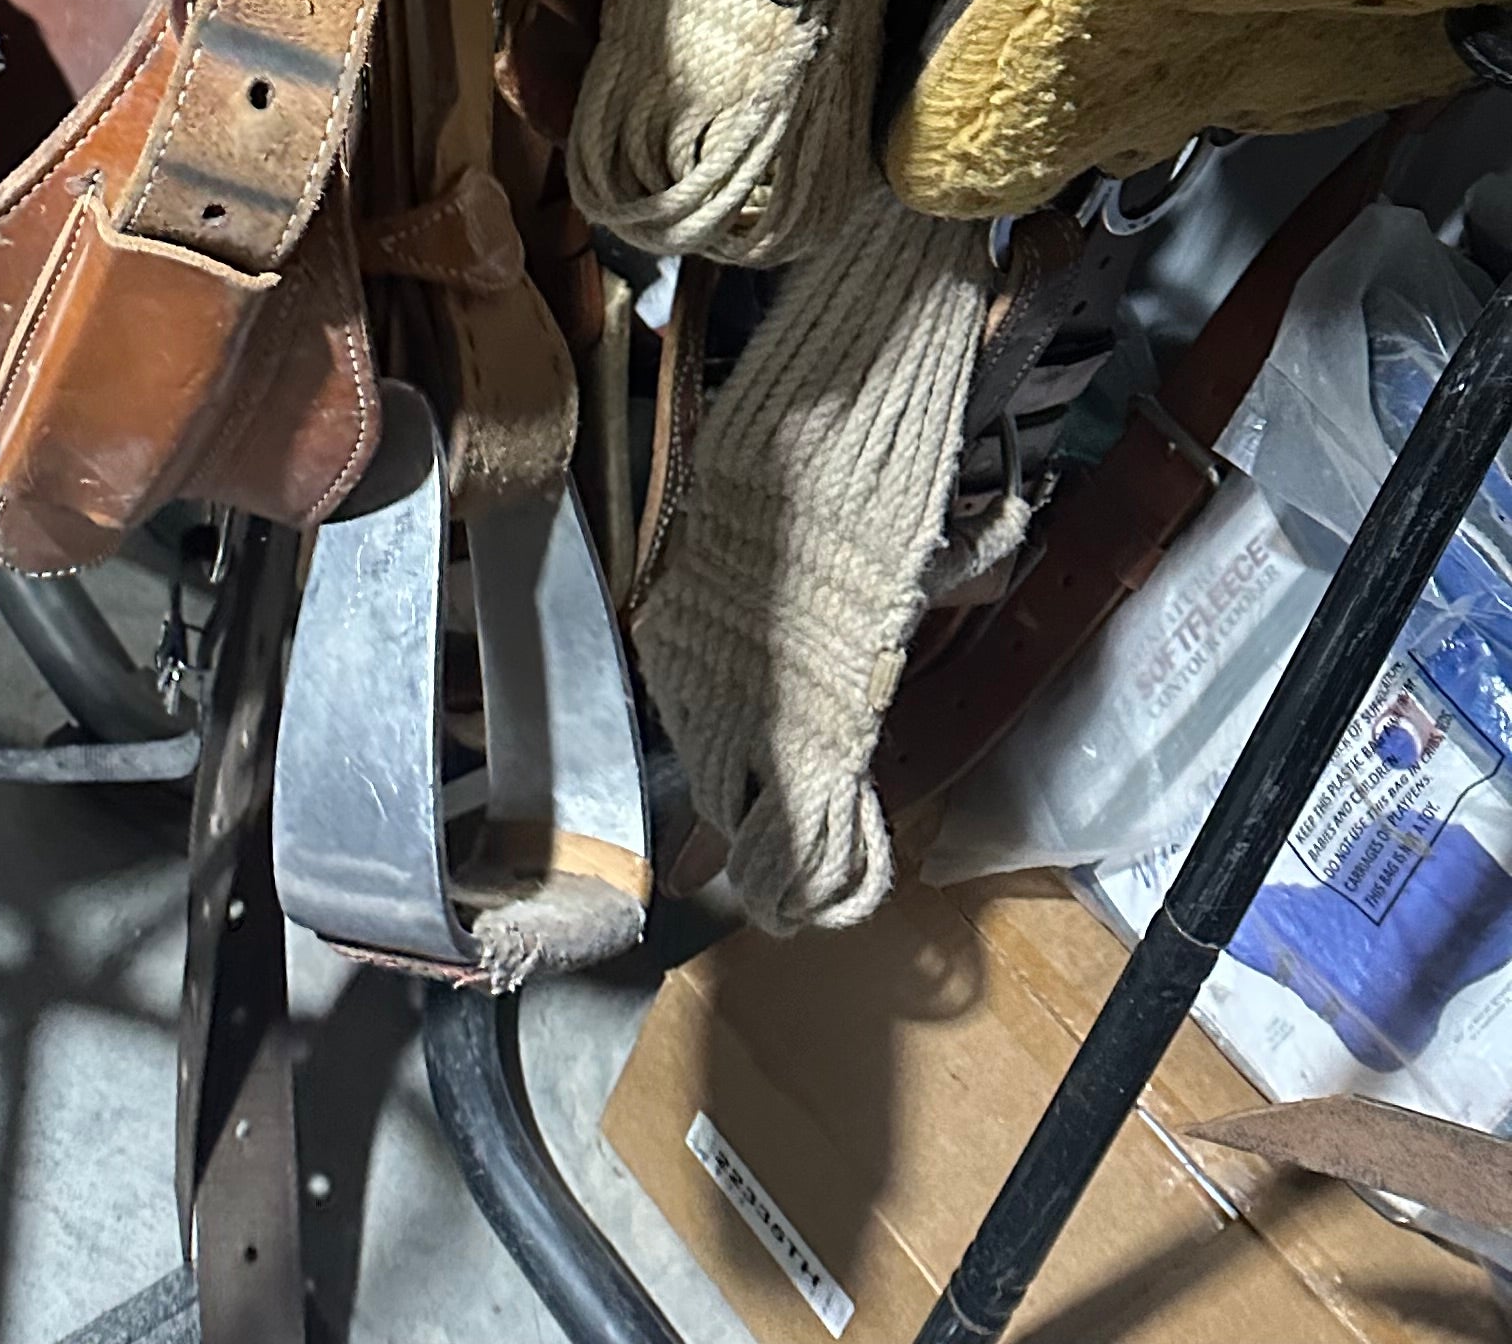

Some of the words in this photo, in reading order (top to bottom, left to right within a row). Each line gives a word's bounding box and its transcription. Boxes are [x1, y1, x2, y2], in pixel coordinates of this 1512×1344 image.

[1136, 536, 1270, 700] SOFTFLEECE
[1295, 816, 1315, 844] KEEP
[1313, 792, 1332, 818] THIS
[1327, 754, 1364, 798] PLASTIC
[1308, 821, 1337, 862] BABIES
[1333, 801, 1352, 828] AND
[1323, 860, 1340, 879] DO
[1338, 834, 1355, 863] NOT
[1350, 817, 1370, 841] USE
[1367, 795, 1389, 821] THIS
[1388, 774, 1409, 799] BAG
[1407, 762, 1422, 777] IN
[1344, 839, 1385, 892] CARRIAGES
[1364, 882, 1386, 908] THIS
[1379, 862, 1400, 887] BAG
[1394, 850, 1407, 864] IS
[1412, 824, 1424, 835] A
